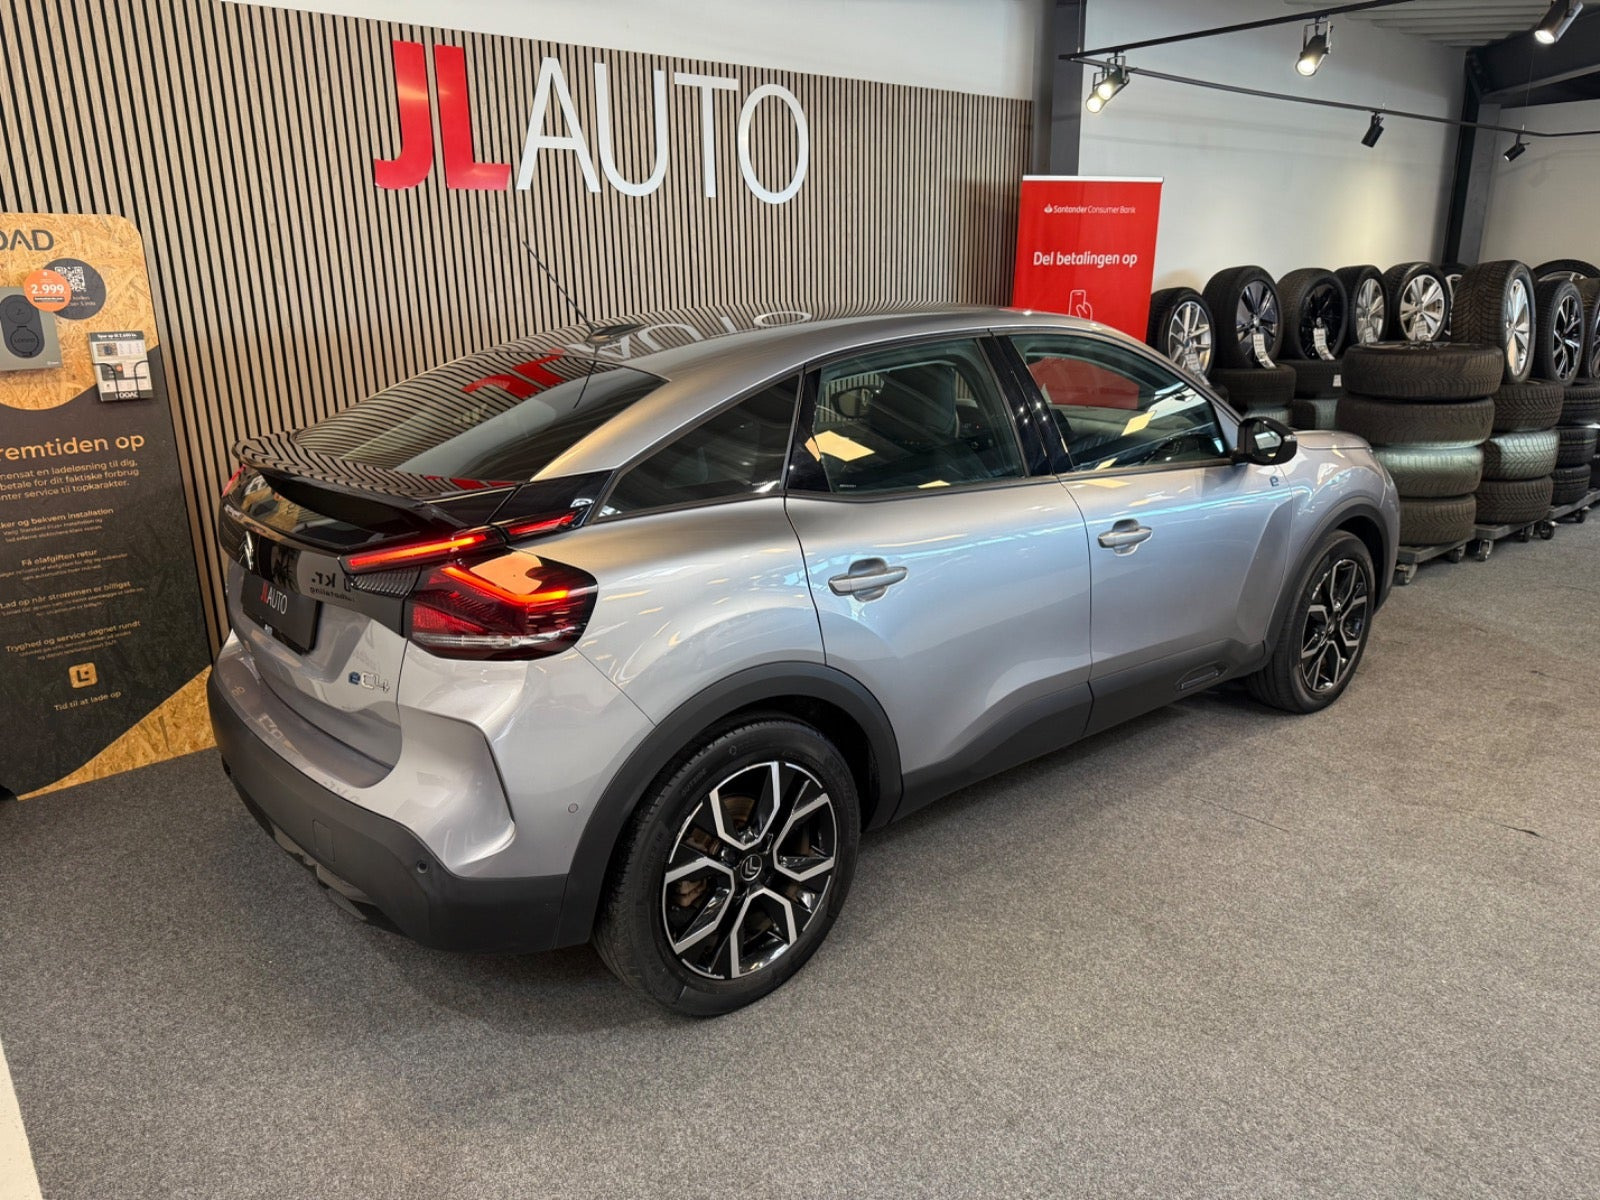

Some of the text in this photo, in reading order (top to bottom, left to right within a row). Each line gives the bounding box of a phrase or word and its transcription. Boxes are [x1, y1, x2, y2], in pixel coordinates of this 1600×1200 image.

[1053, 204, 1136, 214] Santander Consumer Bank
[1033, 251, 1137, 268] Del betalingen op
[115, 434, 145, 451] op
[37, 469, 50, 477] en
[52, 461, 107, 475] ladeløsning
[109, 459, 118, 468] til
[34, 477, 47, 487] for
[50, 476, 64, 486] dit
[65, 472, 103, 484] faktiske
[104, 468, 139, 479] forbrug
[0, 491, 21, 501] nter
[24, 488, 59, 499] service
[61, 485, 71, 494] til
[0, 520, 15, 529] ker
[17, 519, 30, 528] og
[31, 513, 66, 525] bekvem
[68, 507, 114, 519] installation
[18, 598, 30, 607] op
[5, 640, 42, 653] Tryghed
[43, 638, 56, 646] og
[57, 631, 86, 643] service
[118, 620, 141, 631] rundt
[54, 703, 68, 711] Tid
[80, 698, 89, 706] at
[110, 690, 122, 699] op
